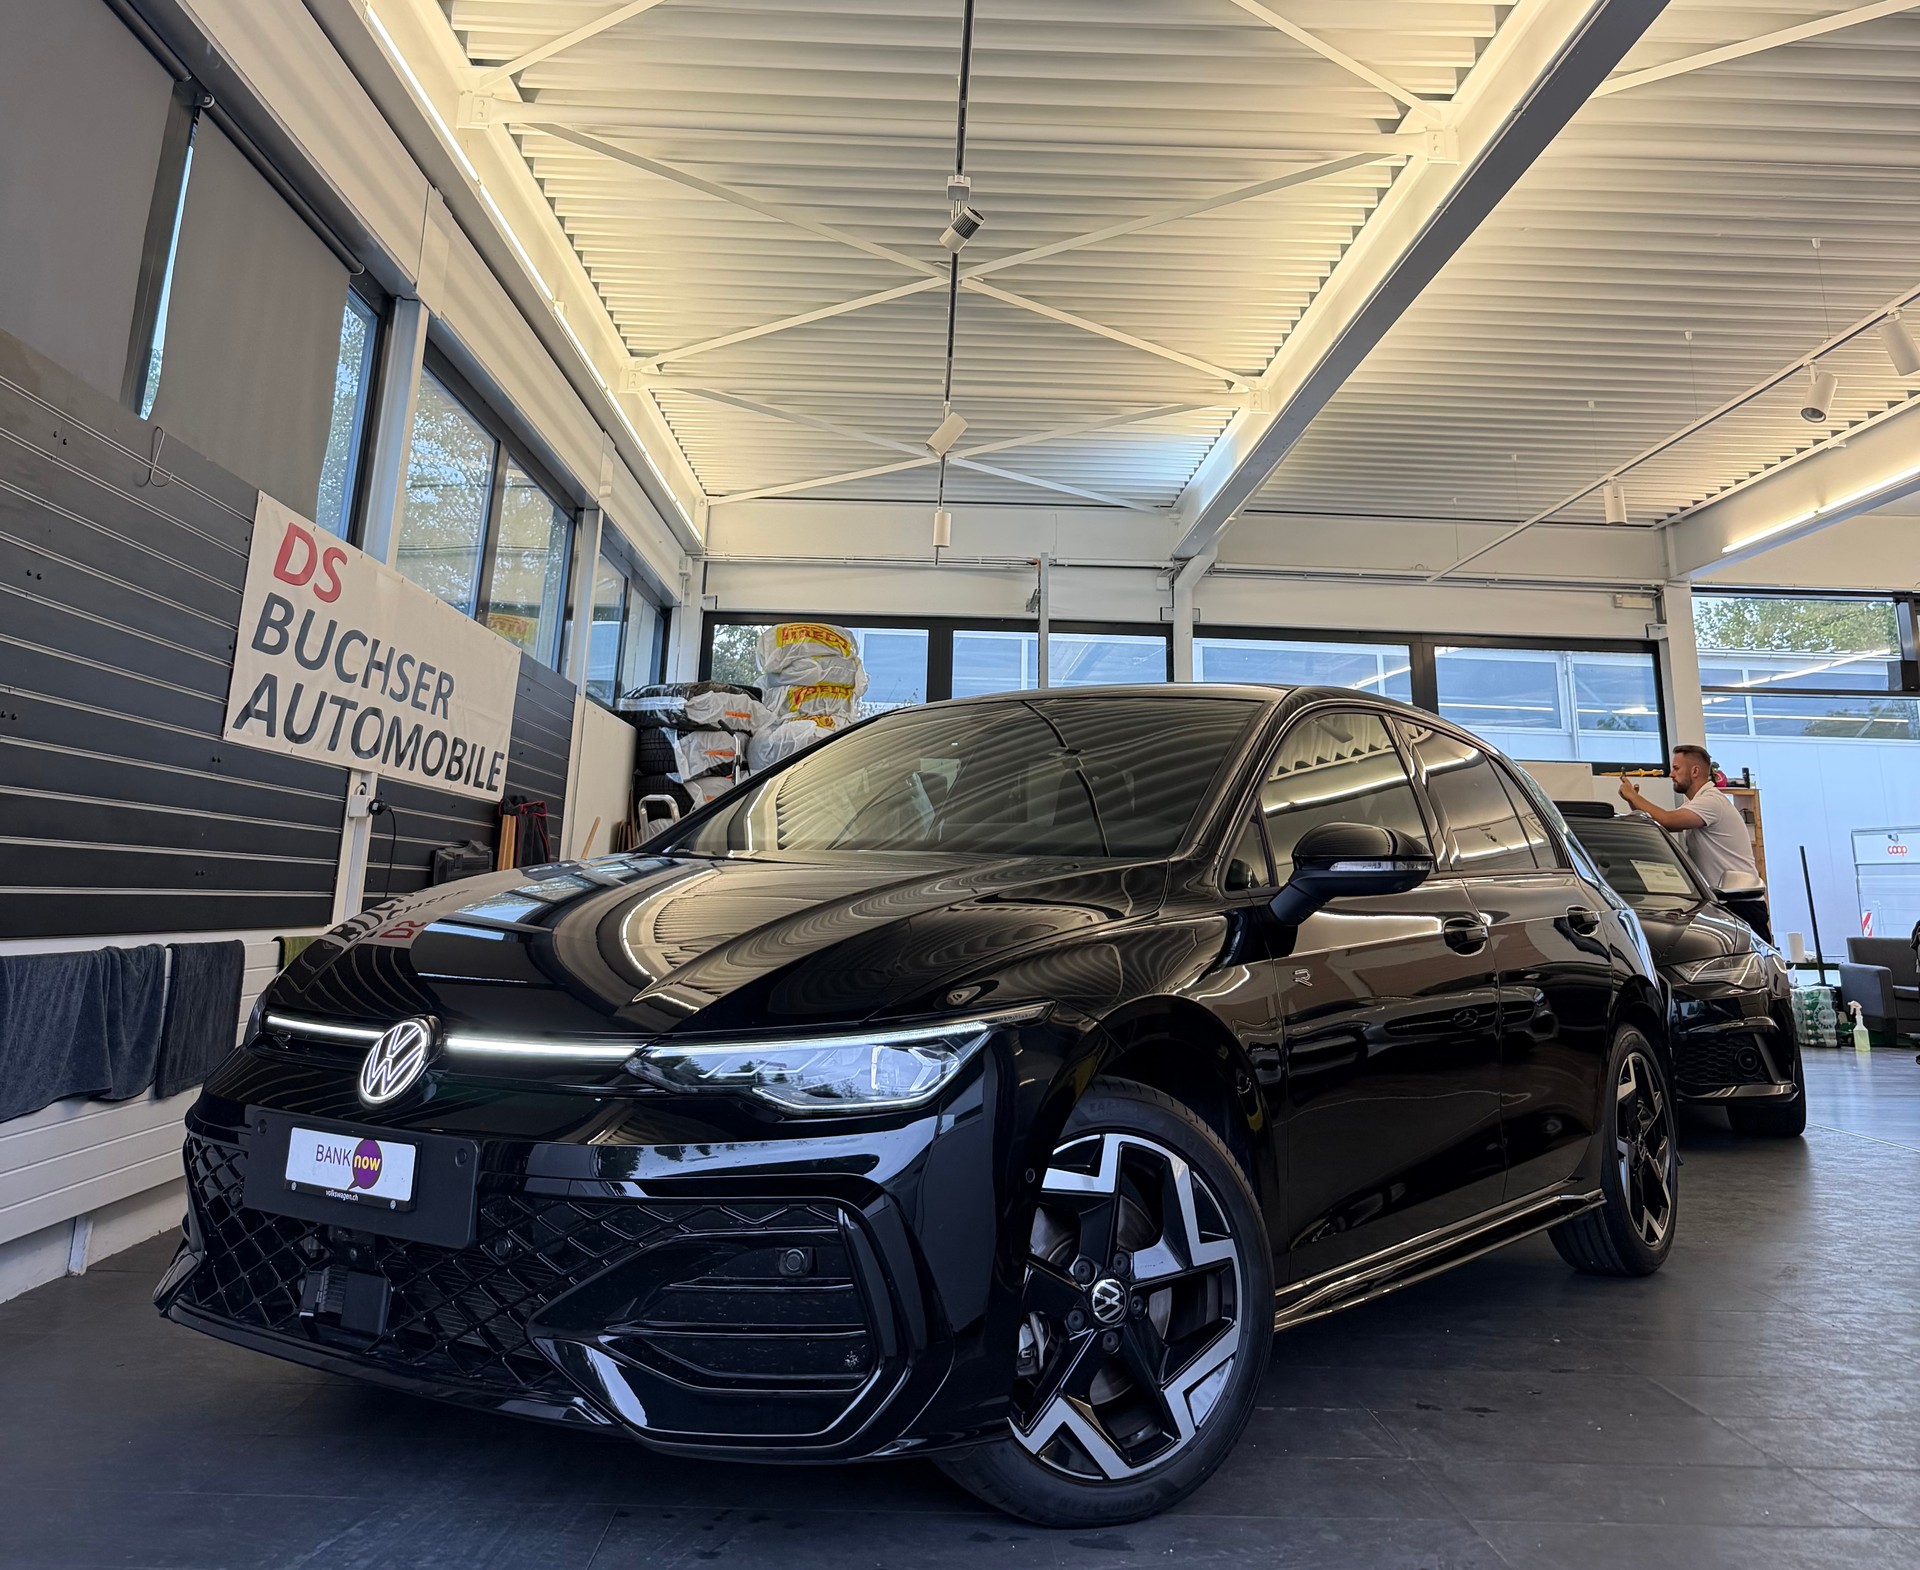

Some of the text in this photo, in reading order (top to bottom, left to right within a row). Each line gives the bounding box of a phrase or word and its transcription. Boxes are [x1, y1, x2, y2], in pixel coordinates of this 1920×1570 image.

[273, 522, 348, 603] DS
[251, 592, 455, 720] BUCHSER
[232, 673, 505, 792] AUTOMOBILE
[315, 1144, 381, 1171] BANK now
[325, 1189, 359, 1202] volkswagen.ch
